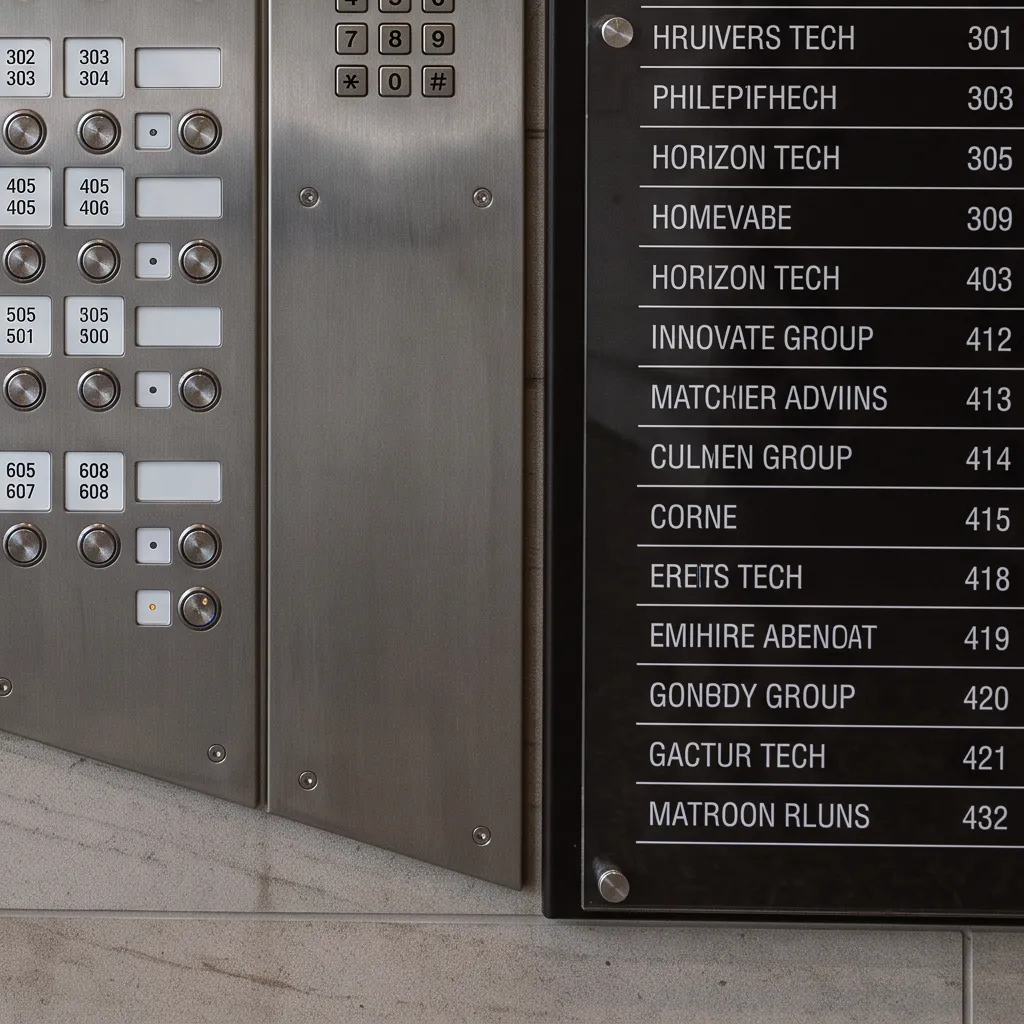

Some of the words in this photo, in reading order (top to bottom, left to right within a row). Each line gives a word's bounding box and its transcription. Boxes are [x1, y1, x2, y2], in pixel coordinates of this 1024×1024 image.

[344, 30, 358, 48] 7
[388, 29, 403, 49] 8
[431, 29, 445, 49] 9
[788, 24, 855, 51] TECH
[967, 25, 1010, 51] 301
[6, 49, 36, 65] 302
[79, 48, 110, 65] 303
[6, 70, 36, 86] 303
[79, 70, 109, 86] 304
[388, 72, 402, 91] 0
[967, 85, 1014, 111] 303
[653, 144, 765, 170] HORIZON
[773, 144, 840, 171] TECH
[967, 145, 1013, 171] 305
[6, 178, 36, 194] 405
[79, 178, 110, 194] 405
[6, 199, 36, 216] 405
[79, 199, 109, 216] 406
[652, 203, 792, 230] HOMEVABE
[967, 206, 1013, 232] 309
[652, 264, 765, 291] HORIZON
[773, 264, 839, 291] TECH
[966, 266, 1012, 292] 403
[6, 306, 36, 323] 505
[6, 328, 33, 344] 501
[652, 324, 775, 351] INNOVATE
[784, 324, 874, 351] GROUP
[966, 326, 1012, 352] 412
[784, 385, 888, 411] ADVIINS
[966, 386, 1012, 412] 413
[763, 444, 853, 471] GROUP
[965, 446, 1011, 471] 414
[6, 462, 36, 479] 605
[79, 462, 109, 479] 608
[6, 483, 36, 499] 607
[79, 483, 109, 500] 608
[650, 503, 737, 530] CORNE
[965, 506, 1010, 532] 415
[737, 563, 802, 590] TECH
[964, 566, 1010, 592] 418
[650, 622, 755, 649] EMIHIRE
[762, 623, 878, 650] ABENOAT
[963, 625, 1010, 651] 419
[766, 683, 856, 710] GROUP
[963, 685, 1009, 711] 420
[649, 741, 752, 768] GACTUR
[760, 742, 825, 769] TECH
[962, 745, 1004, 771] 421
[649, 801, 775, 828] MATROON
[785, 802, 870, 829] RLUNS
[962, 805, 1008, 831] 432
